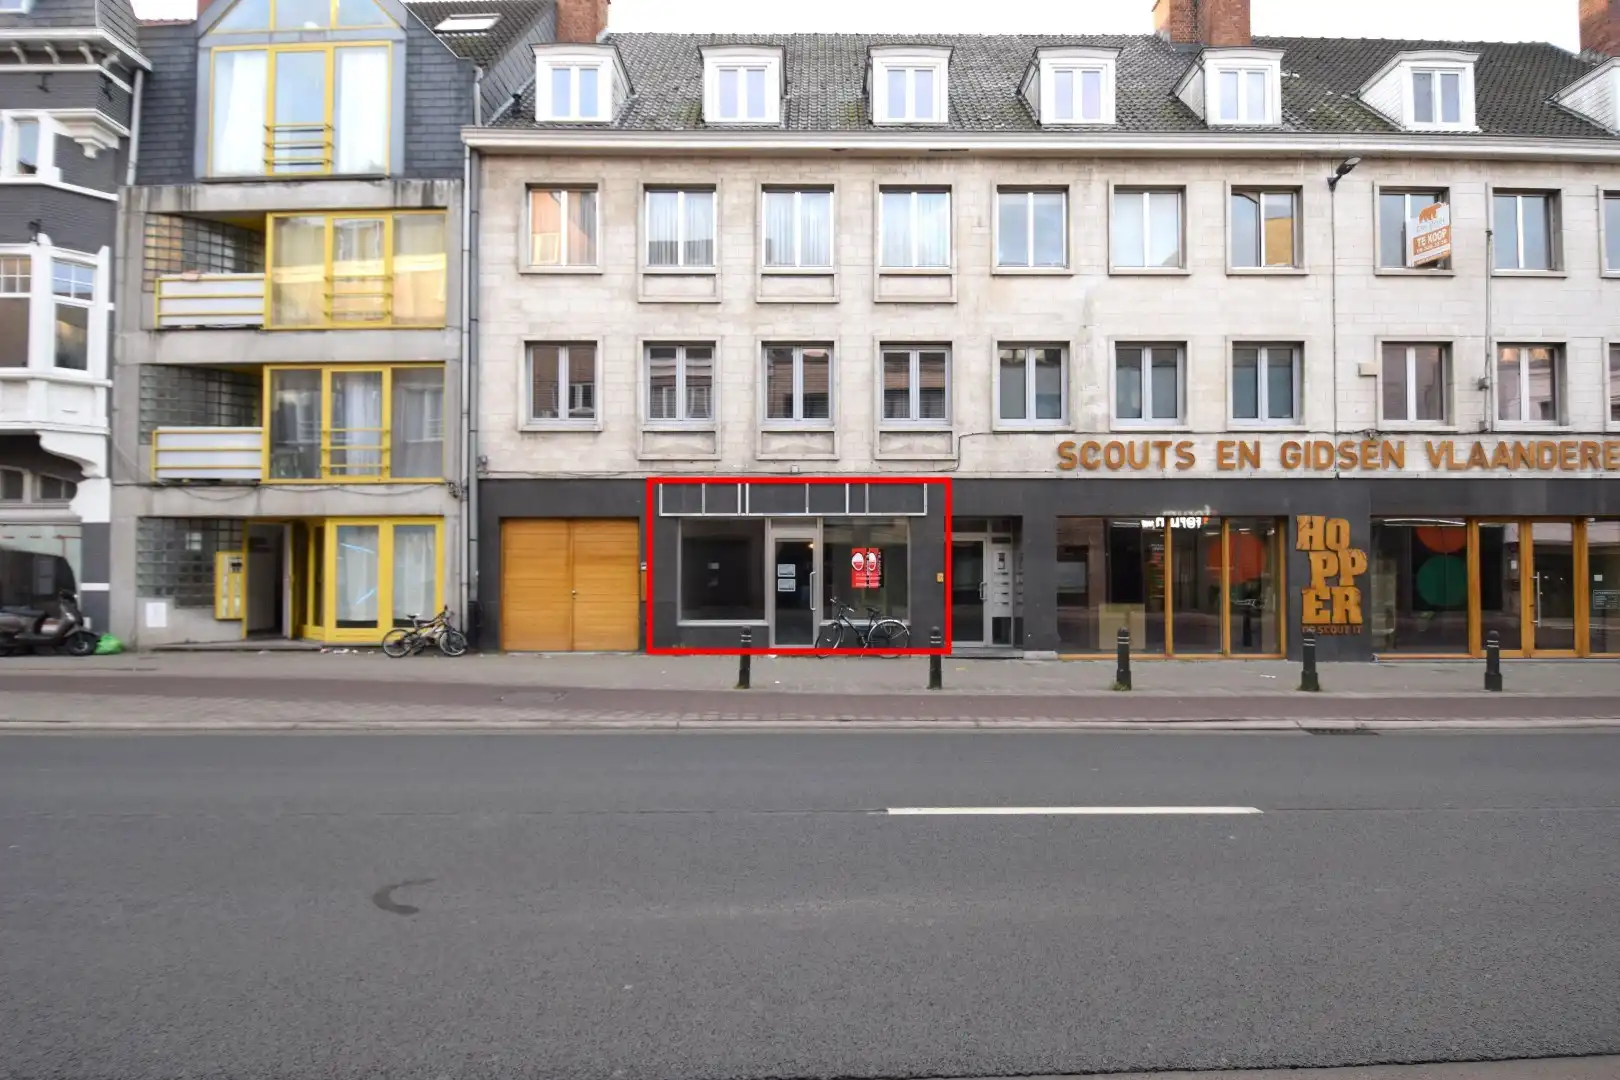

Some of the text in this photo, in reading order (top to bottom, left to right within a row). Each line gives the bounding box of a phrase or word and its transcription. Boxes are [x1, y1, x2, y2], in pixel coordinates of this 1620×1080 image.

[1057, 440, 1620, 471] SCOUTS EN GIDSEN VLAANDERE
